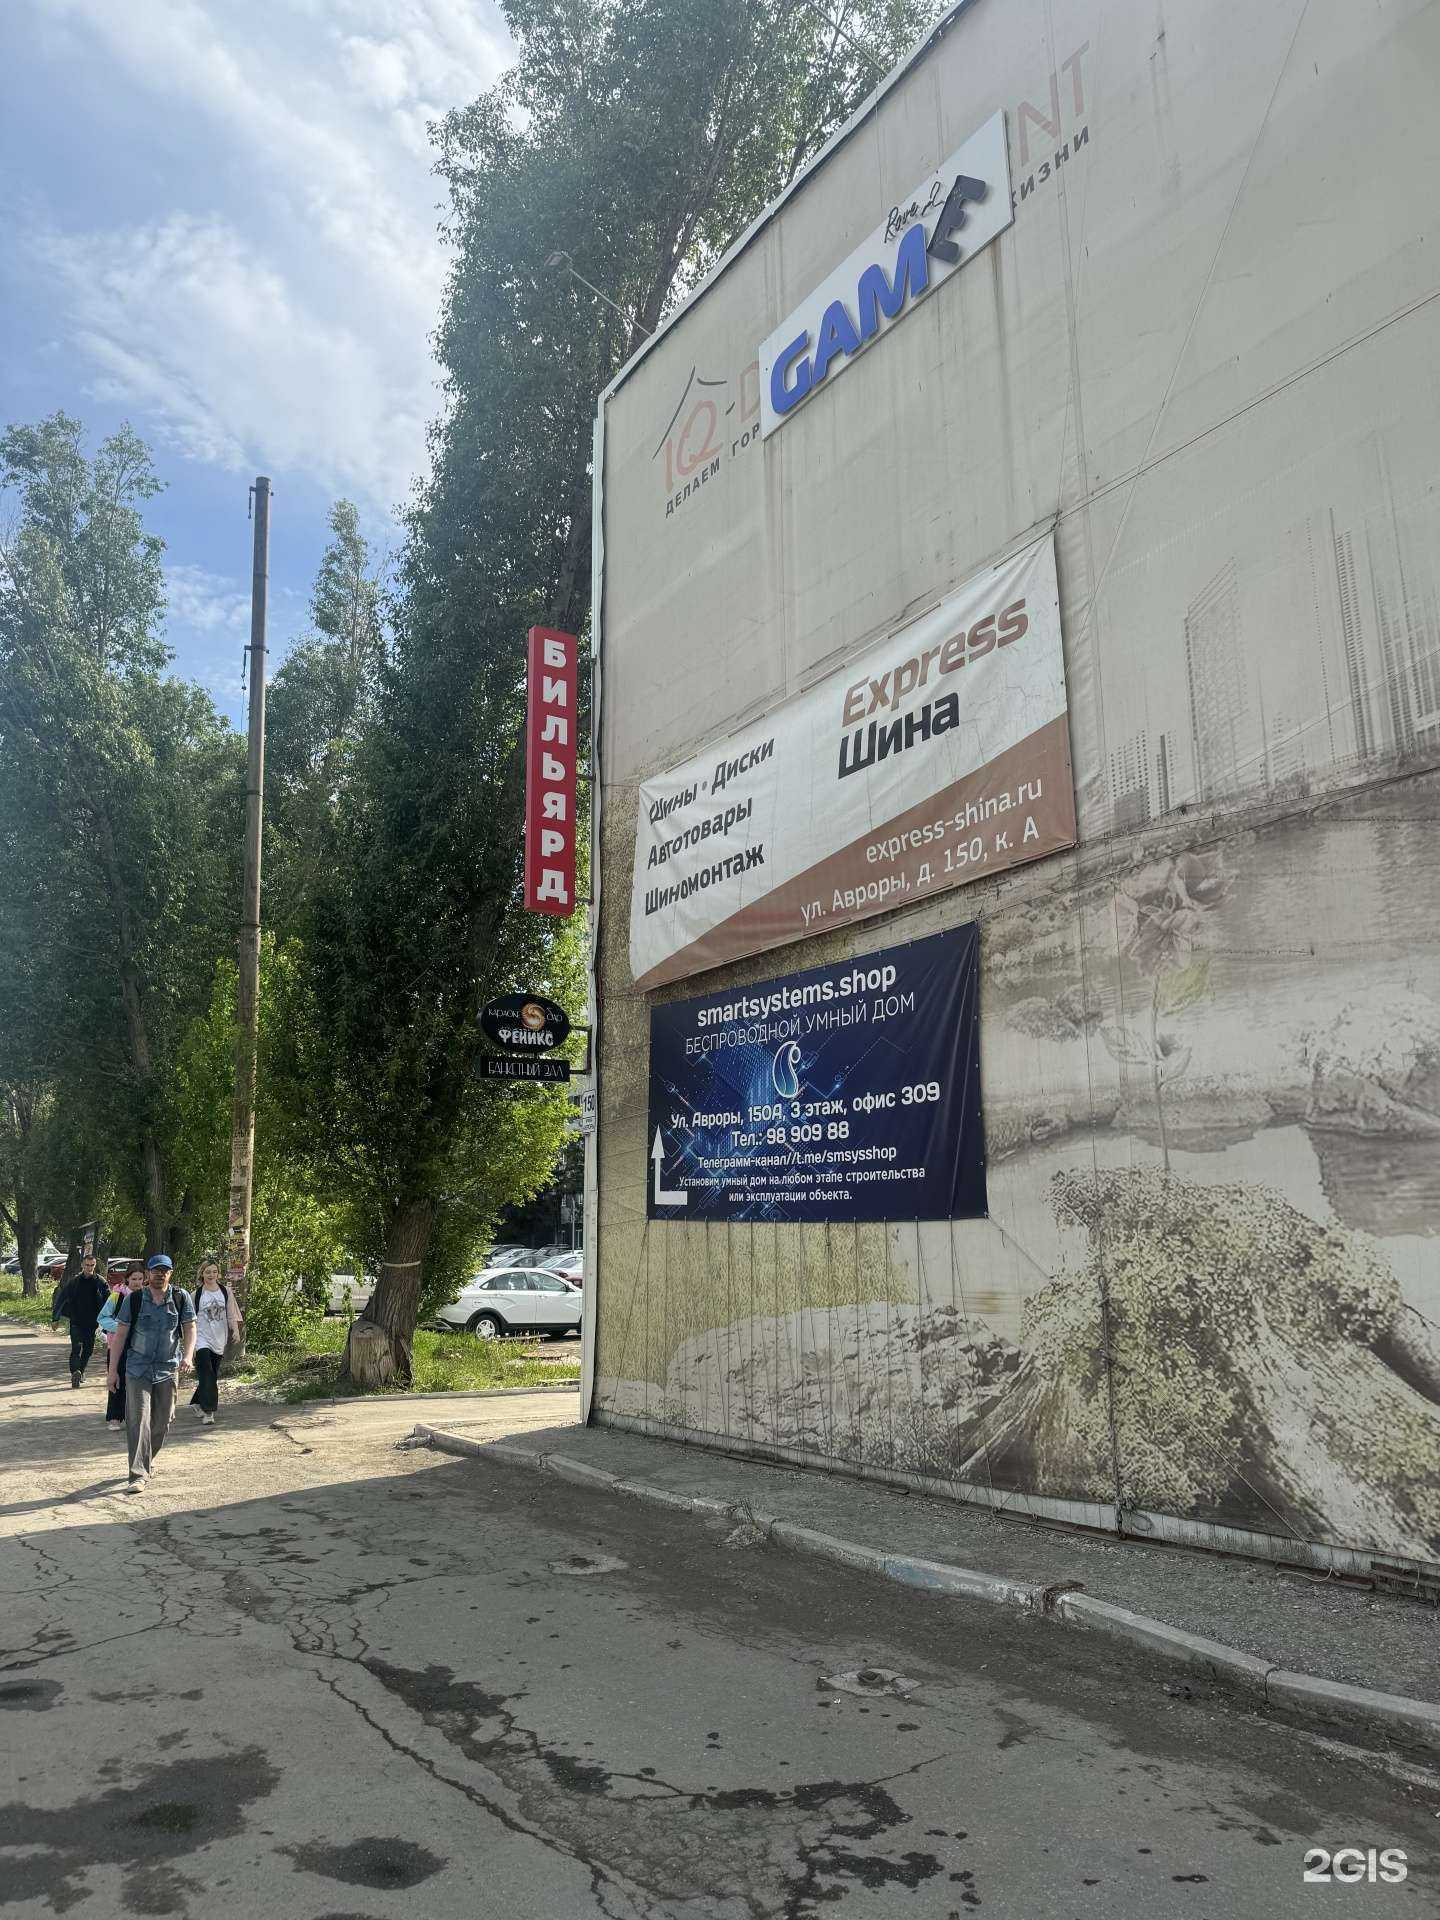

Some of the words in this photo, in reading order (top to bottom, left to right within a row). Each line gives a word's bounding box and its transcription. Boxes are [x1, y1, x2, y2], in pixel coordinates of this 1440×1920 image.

[664, 361, 760, 494] IQ-D
[1018, 40, 1090, 167] NT
[665, 457, 720, 518] ДЕЛАЕМ
[732, 422, 760, 457] ГОР
[842, 598, 1029, 728] Express
[536, 638, 569, 905] БИЛЬЯРД
[838, 693, 960, 779] Шина
[649, 783, 698, 824] Шины
[711, 738, 775, 795] Диски
[647, 798, 753, 870] Автотовары
[866, 778, 1042, 864] express-shina.ru
[645, 844, 765, 916] Шиномонтаж
[801, 902, 827, 927] ул.
[832, 872, 911, 913] Авроры,
[917, 862, 936, 887] д.
[943, 837, 988, 873] 150,
[995, 831, 1014, 852] к.
[1023, 816, 1040, 844] А
[685, 1014, 800, 1055] БЕСПРОВОДНОЙ
[805, 999, 867, 1034] УМНЫЙ
[871, 991, 915, 1024] ДОМ
[697, 964, 897, 1027] smartsystems.shop
[498, 1028, 554, 1047] ФЕНИКС
[671, 1113, 689, 1129] Ул.
[692, 1111, 744, 1130] Авроры,
[790, 1101, 801, 1118] 3
[804, 1099, 848, 1117] этаж,
[852, 1092, 896, 1114] офис
[901, 1081, 940, 1105] 309
[732, 1131, 763, 1147] Тел.:
[766, 1127, 786, 1144] 98
[790, 1123, 822, 1142] 909
[827, 1121, 849, 1140] 88
[679, 1177, 720, 1187] Установим
[721, 1175, 748, 1188] умный
[749, 1177, 767, 1187] дом
[781, 1173, 813, 1185] любом
[815, 1173, 843, 1183] этапе
[845, 1166, 926, 1184] строительства
[728, 1191, 744, 1202] или
[745, 1189, 807, 1204] эксплуатации
[809, 1187, 853, 1201] объекта.
